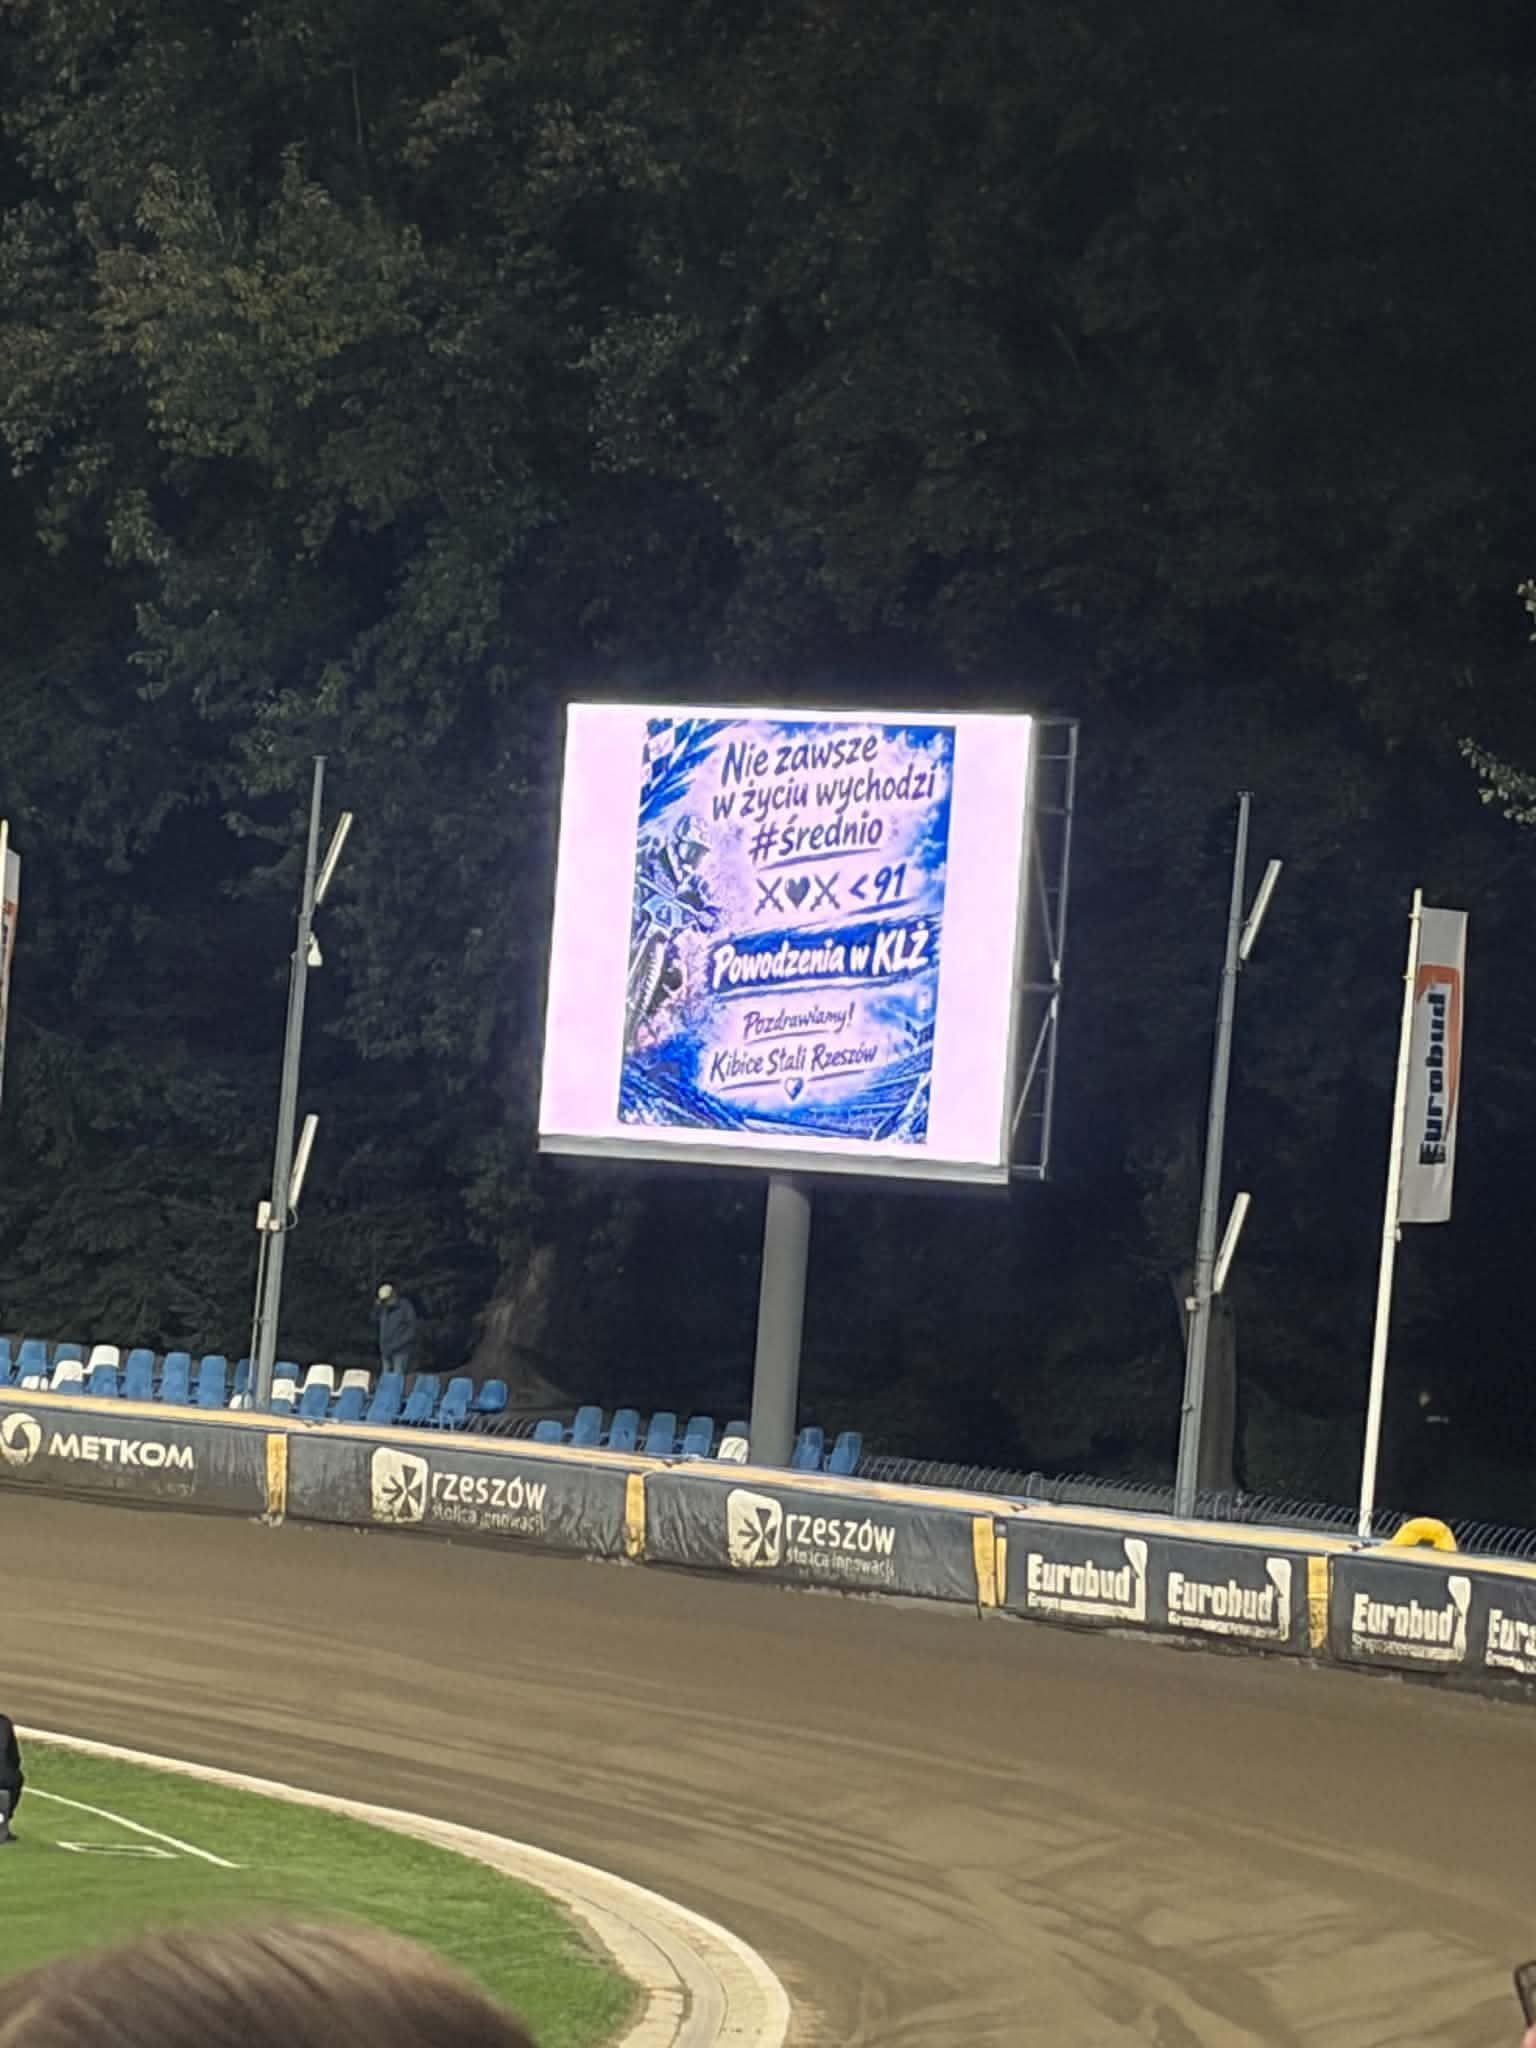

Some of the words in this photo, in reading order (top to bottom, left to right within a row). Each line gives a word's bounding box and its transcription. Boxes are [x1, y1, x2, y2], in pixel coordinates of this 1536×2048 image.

[721, 742, 768, 786] Nie
[773, 735, 878, 776] zawsze
[712, 794, 732, 821] w
[739, 778, 808, 822] życiu
[816, 763, 937, 814] wychodzi
[749, 812, 882, 863] #średnio
[712, 941, 845, 989] Powodzenia
[850, 950, 871, 973] w
[743, 1003, 856, 1034] Pozdrawiamy!
[709, 1050, 764, 1083] Kibice
[765, 1046, 806, 1076] Stali
[811, 1043, 879, 1071] Rzeszów
[48, 1432, 194, 1470] METKOM
[431, 1471, 547, 1512] rzeszów
[785, 1513, 896, 1555] rzeszów
[1027, 1553, 1131, 1602] Eurobud
[1168, 1571, 1274, 1622] Eurobud
[1352, 1592, 1454, 1642] Eurobud
